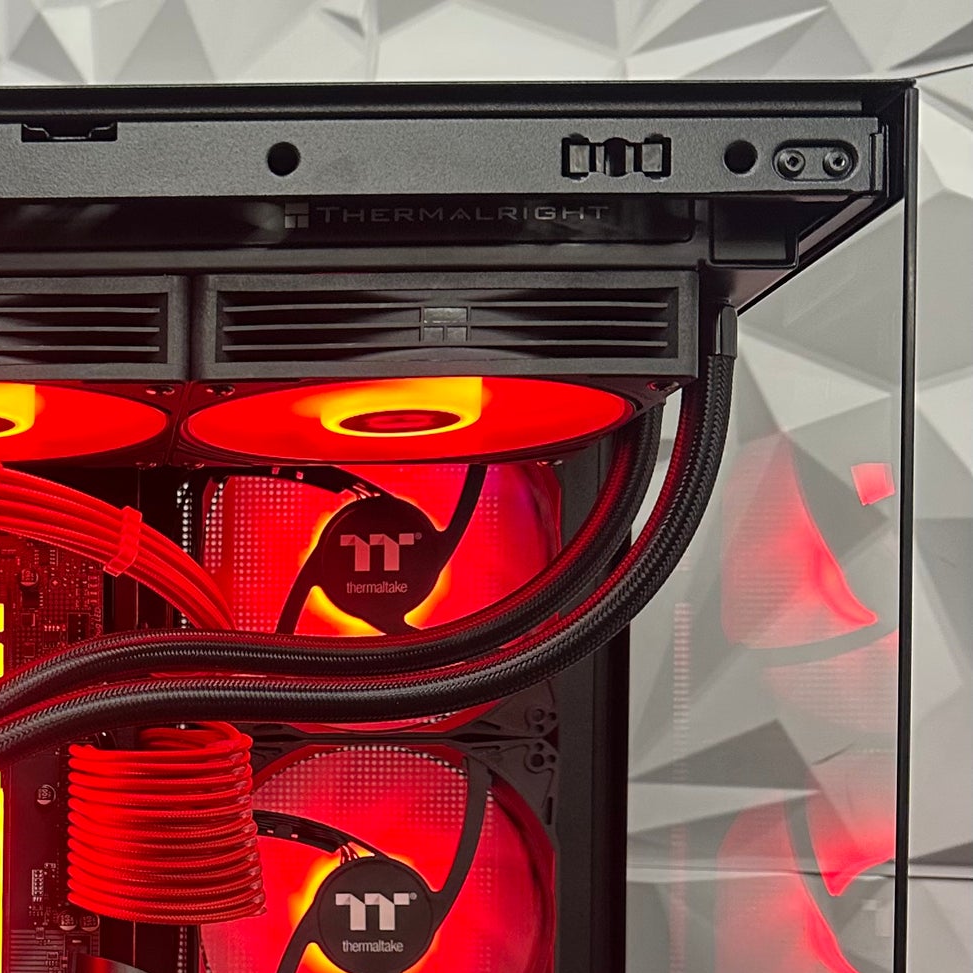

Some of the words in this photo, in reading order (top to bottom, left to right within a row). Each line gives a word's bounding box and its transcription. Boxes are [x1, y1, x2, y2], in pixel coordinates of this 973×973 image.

[316, 206, 609, 223] THERMALRIGHT
[347, 581, 408, 594] thermaltake
[342, 940, 404, 953] thermaltake
